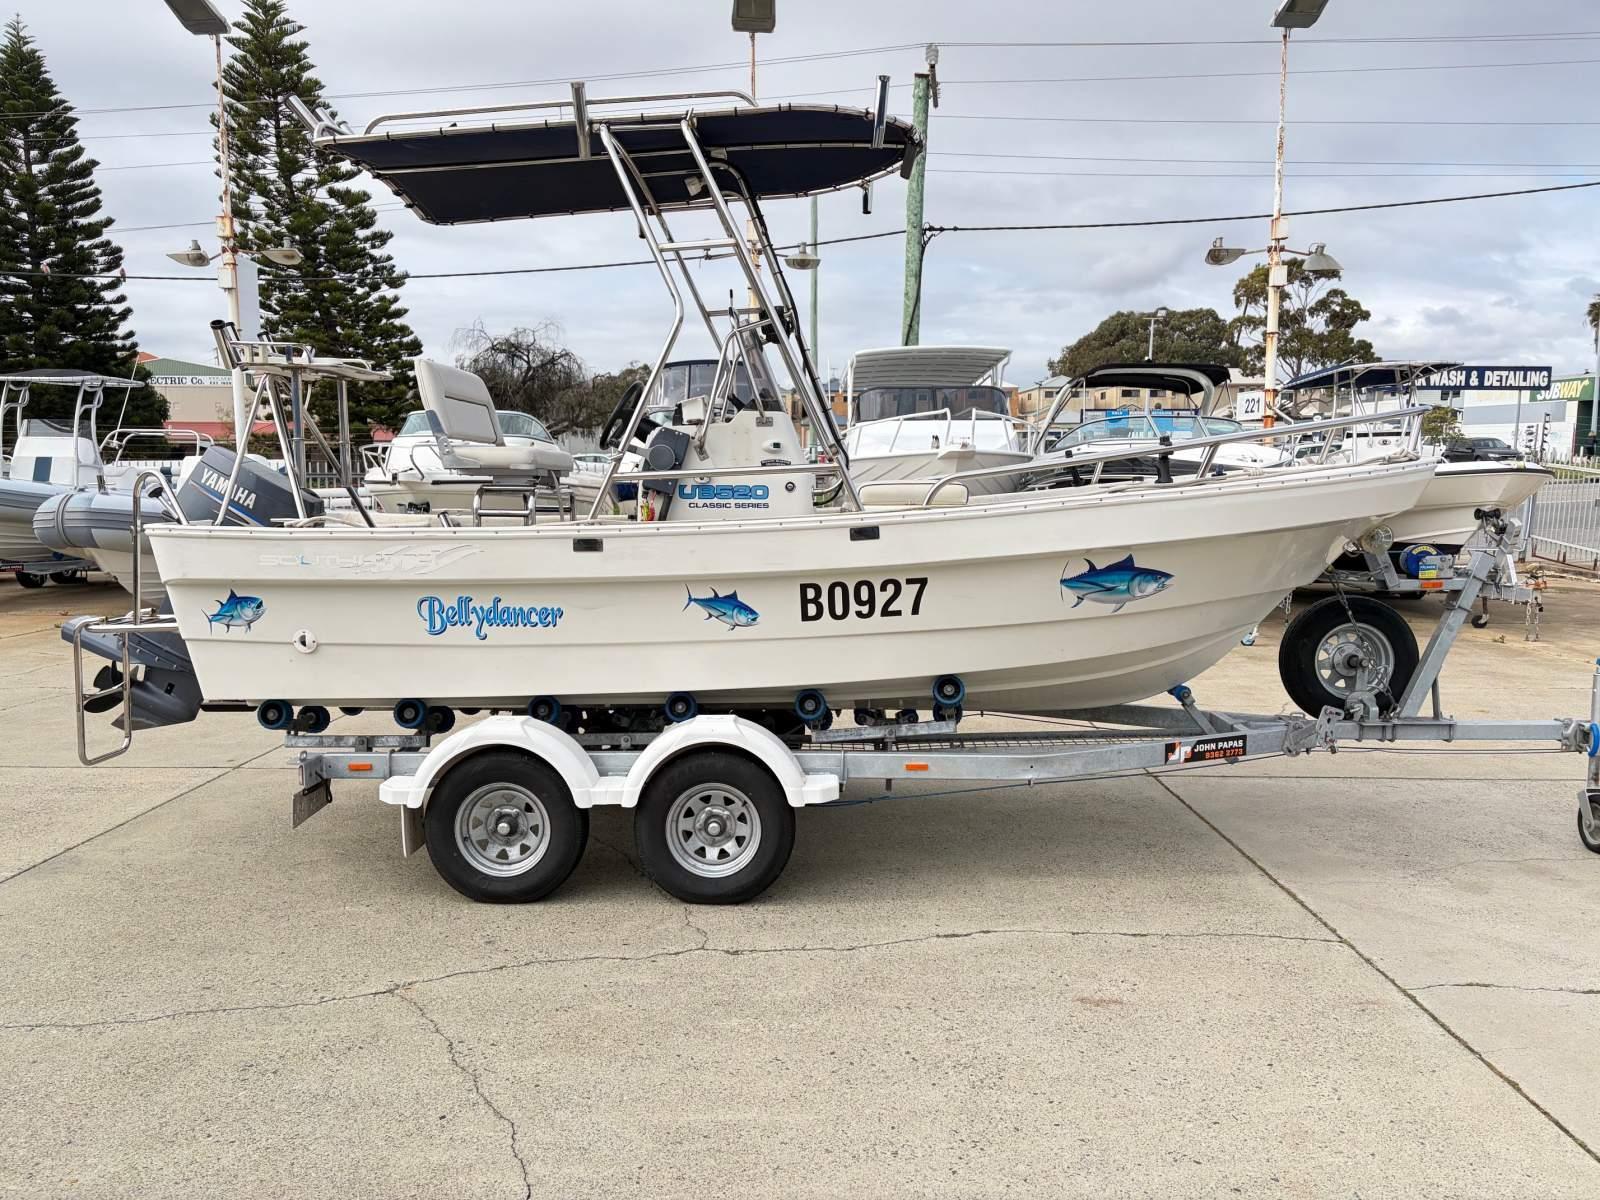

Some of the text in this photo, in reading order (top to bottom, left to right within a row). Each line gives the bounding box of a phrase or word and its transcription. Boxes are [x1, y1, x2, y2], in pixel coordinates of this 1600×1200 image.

[150, 376, 187, 385] ECTRIC
[1430, 370, 1466, 386] WASH
[1470, 370, 1479, 385] &
[1484, 370, 1549, 386] DETAILING
[1536, 378, 1590, 400] SUBWAY
[1245, 397, 1260, 414] 221
[678, 484, 769, 500] UB520
[799, 577, 929, 622] B0927
[416, 596, 564, 641] Bellydancer
[1193, 740, 1244, 752] JOHN PAPAS
